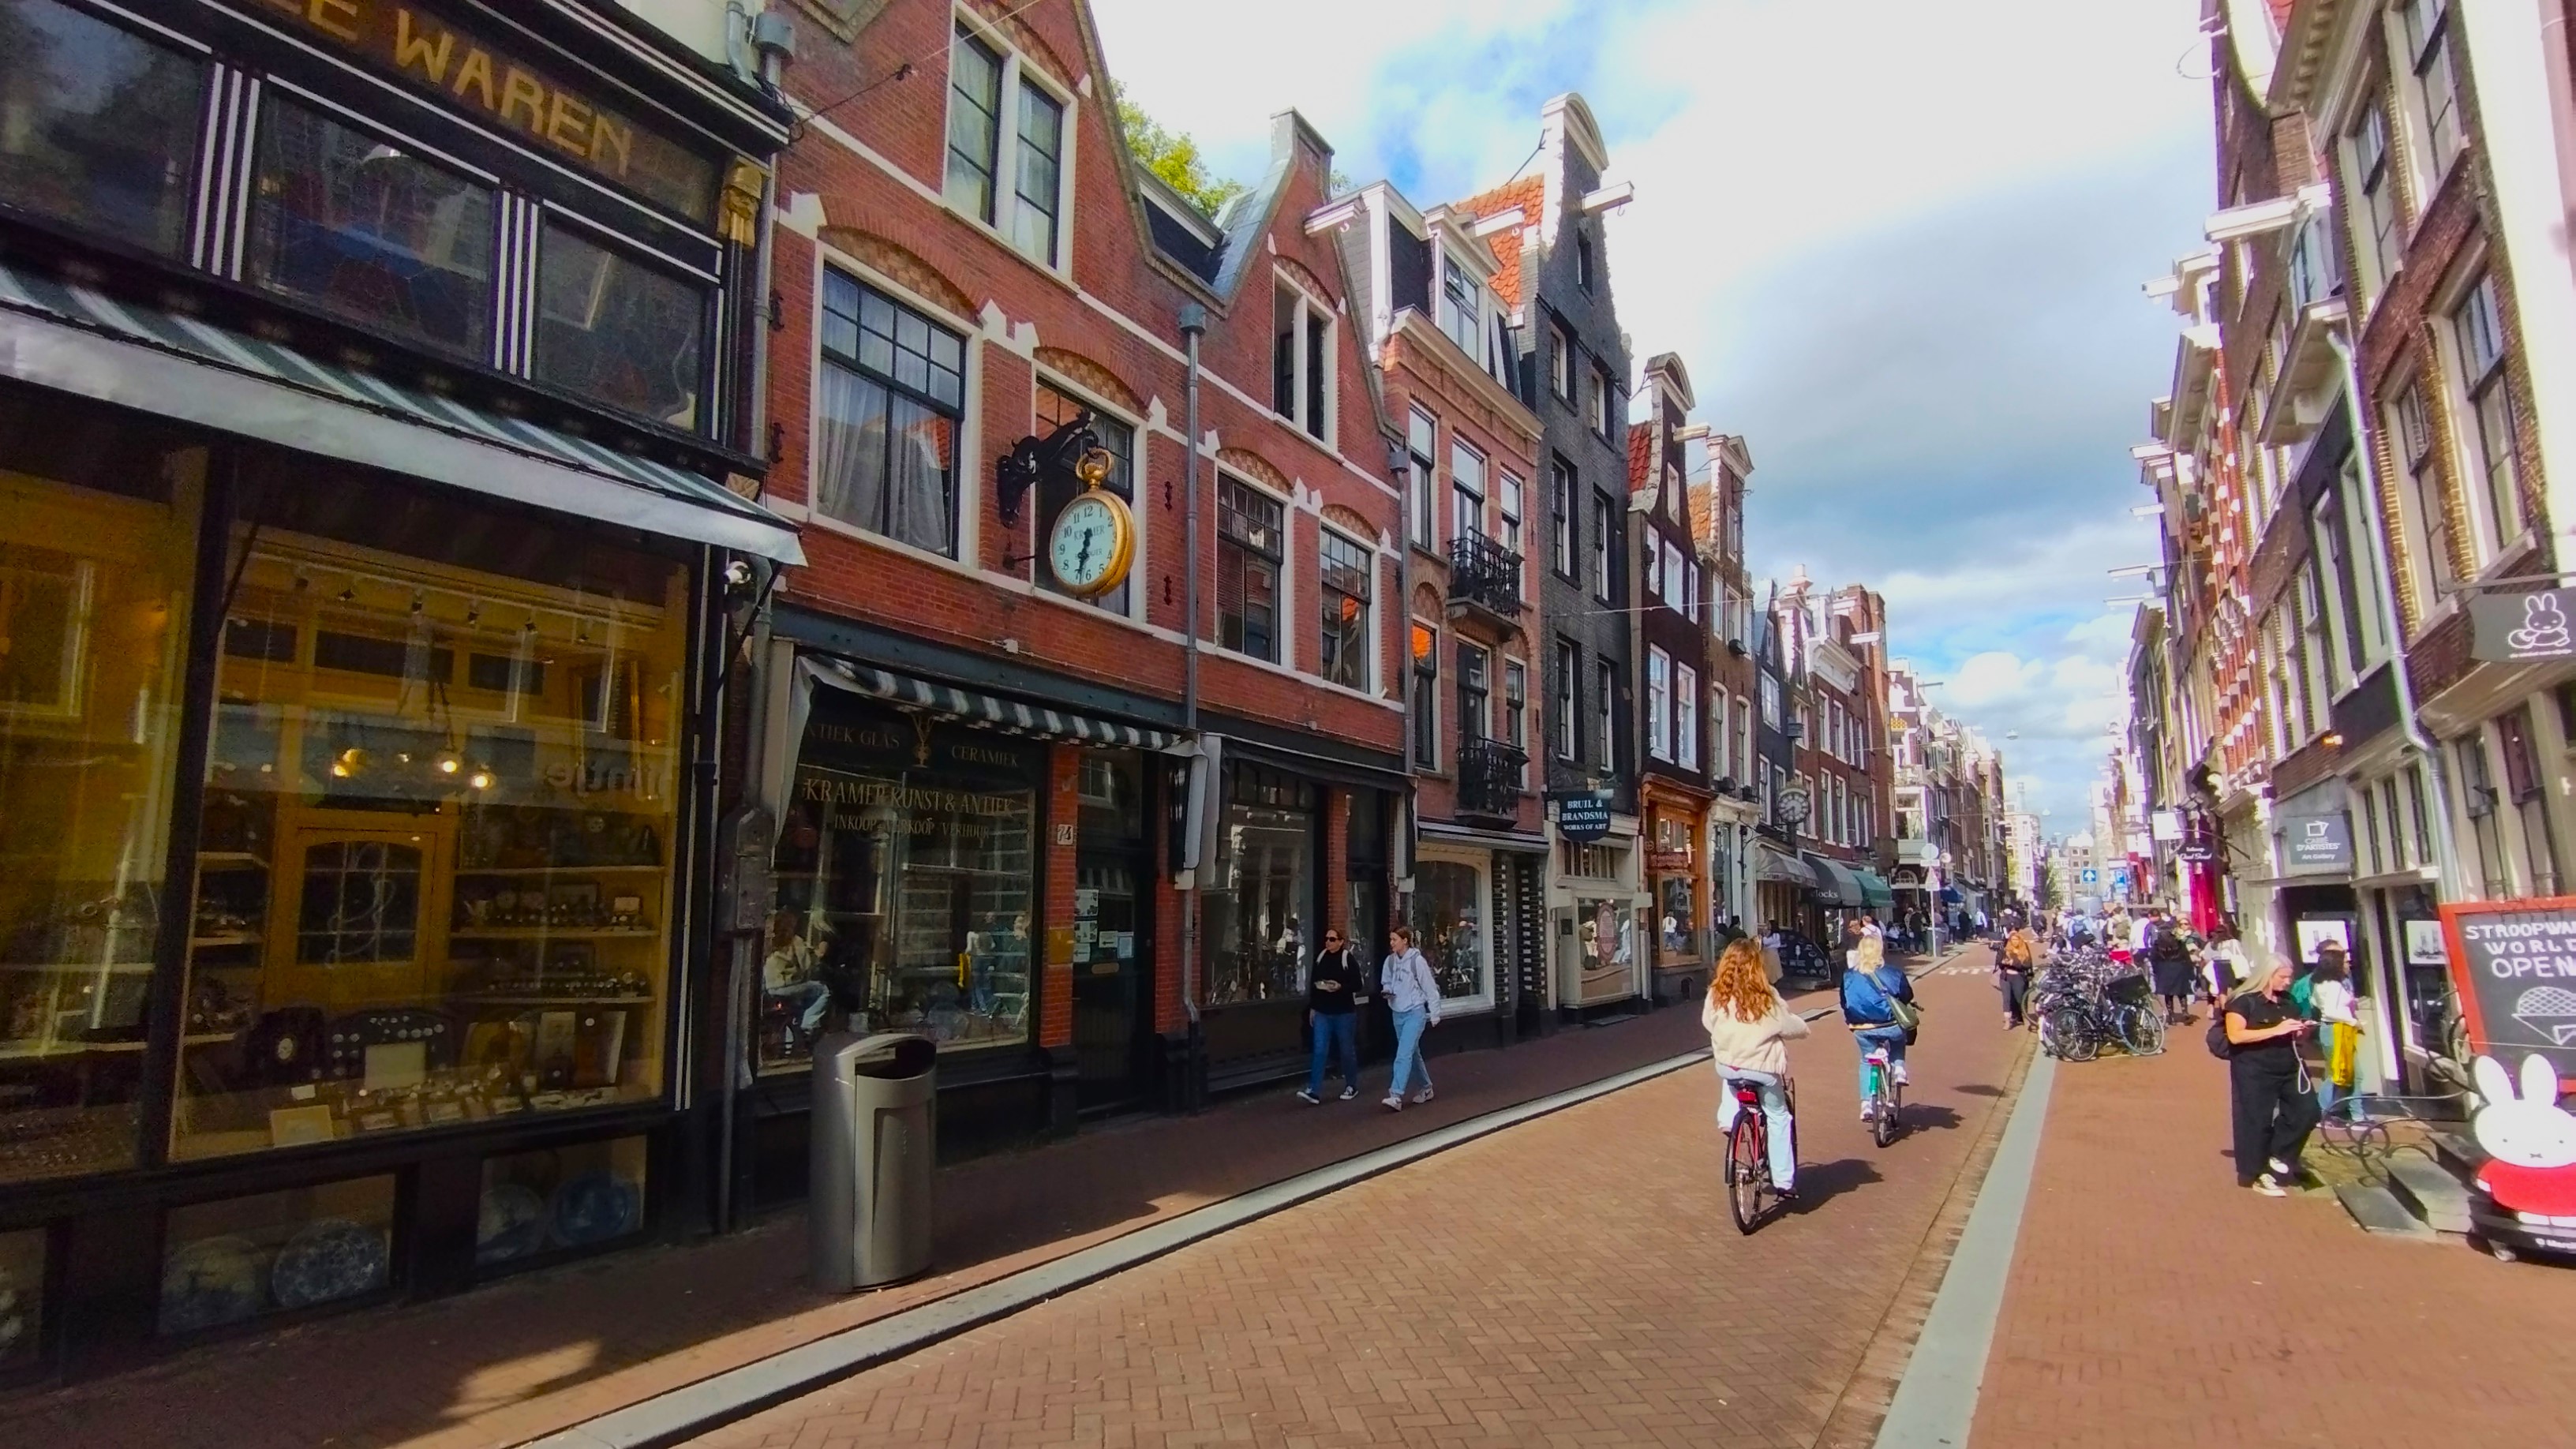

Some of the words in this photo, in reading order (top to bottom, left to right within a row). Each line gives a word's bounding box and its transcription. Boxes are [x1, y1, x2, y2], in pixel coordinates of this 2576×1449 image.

[395, 9, 631, 177] WAREN
[1084, 505, 1094, 518] 12
[1073, 513, 1080, 524] 11
[1107, 516, 1114, 527] 2
[1064, 526, 1072, 537] 10
[1058, 544, 1065, 555] 9
[1106, 549, 1112, 561] 4
[1061, 560, 1069, 571] 8
[1099, 564, 1105, 575] 5
[1085, 569, 1092, 581] 6
[860, 729, 900, 749] GLAS
[951, 744, 1020, 768] CERAMIEK
[804, 777, 886, 803] KRAMER
[890, 787, 942, 811] KUNST
[945, 792, 955, 813] &
[961, 794, 1014, 815] ANTIEK
[1567, 799, 1593, 809] BRUIL
[834, 813, 878, 831] INKOOP
[1561, 811, 1608, 822] BRANDSMA
[1057, 825, 1072, 842] 74
[2465, 920, 2576, 940] STROOPWA
[2491, 954, 2576, 979] OPEN
